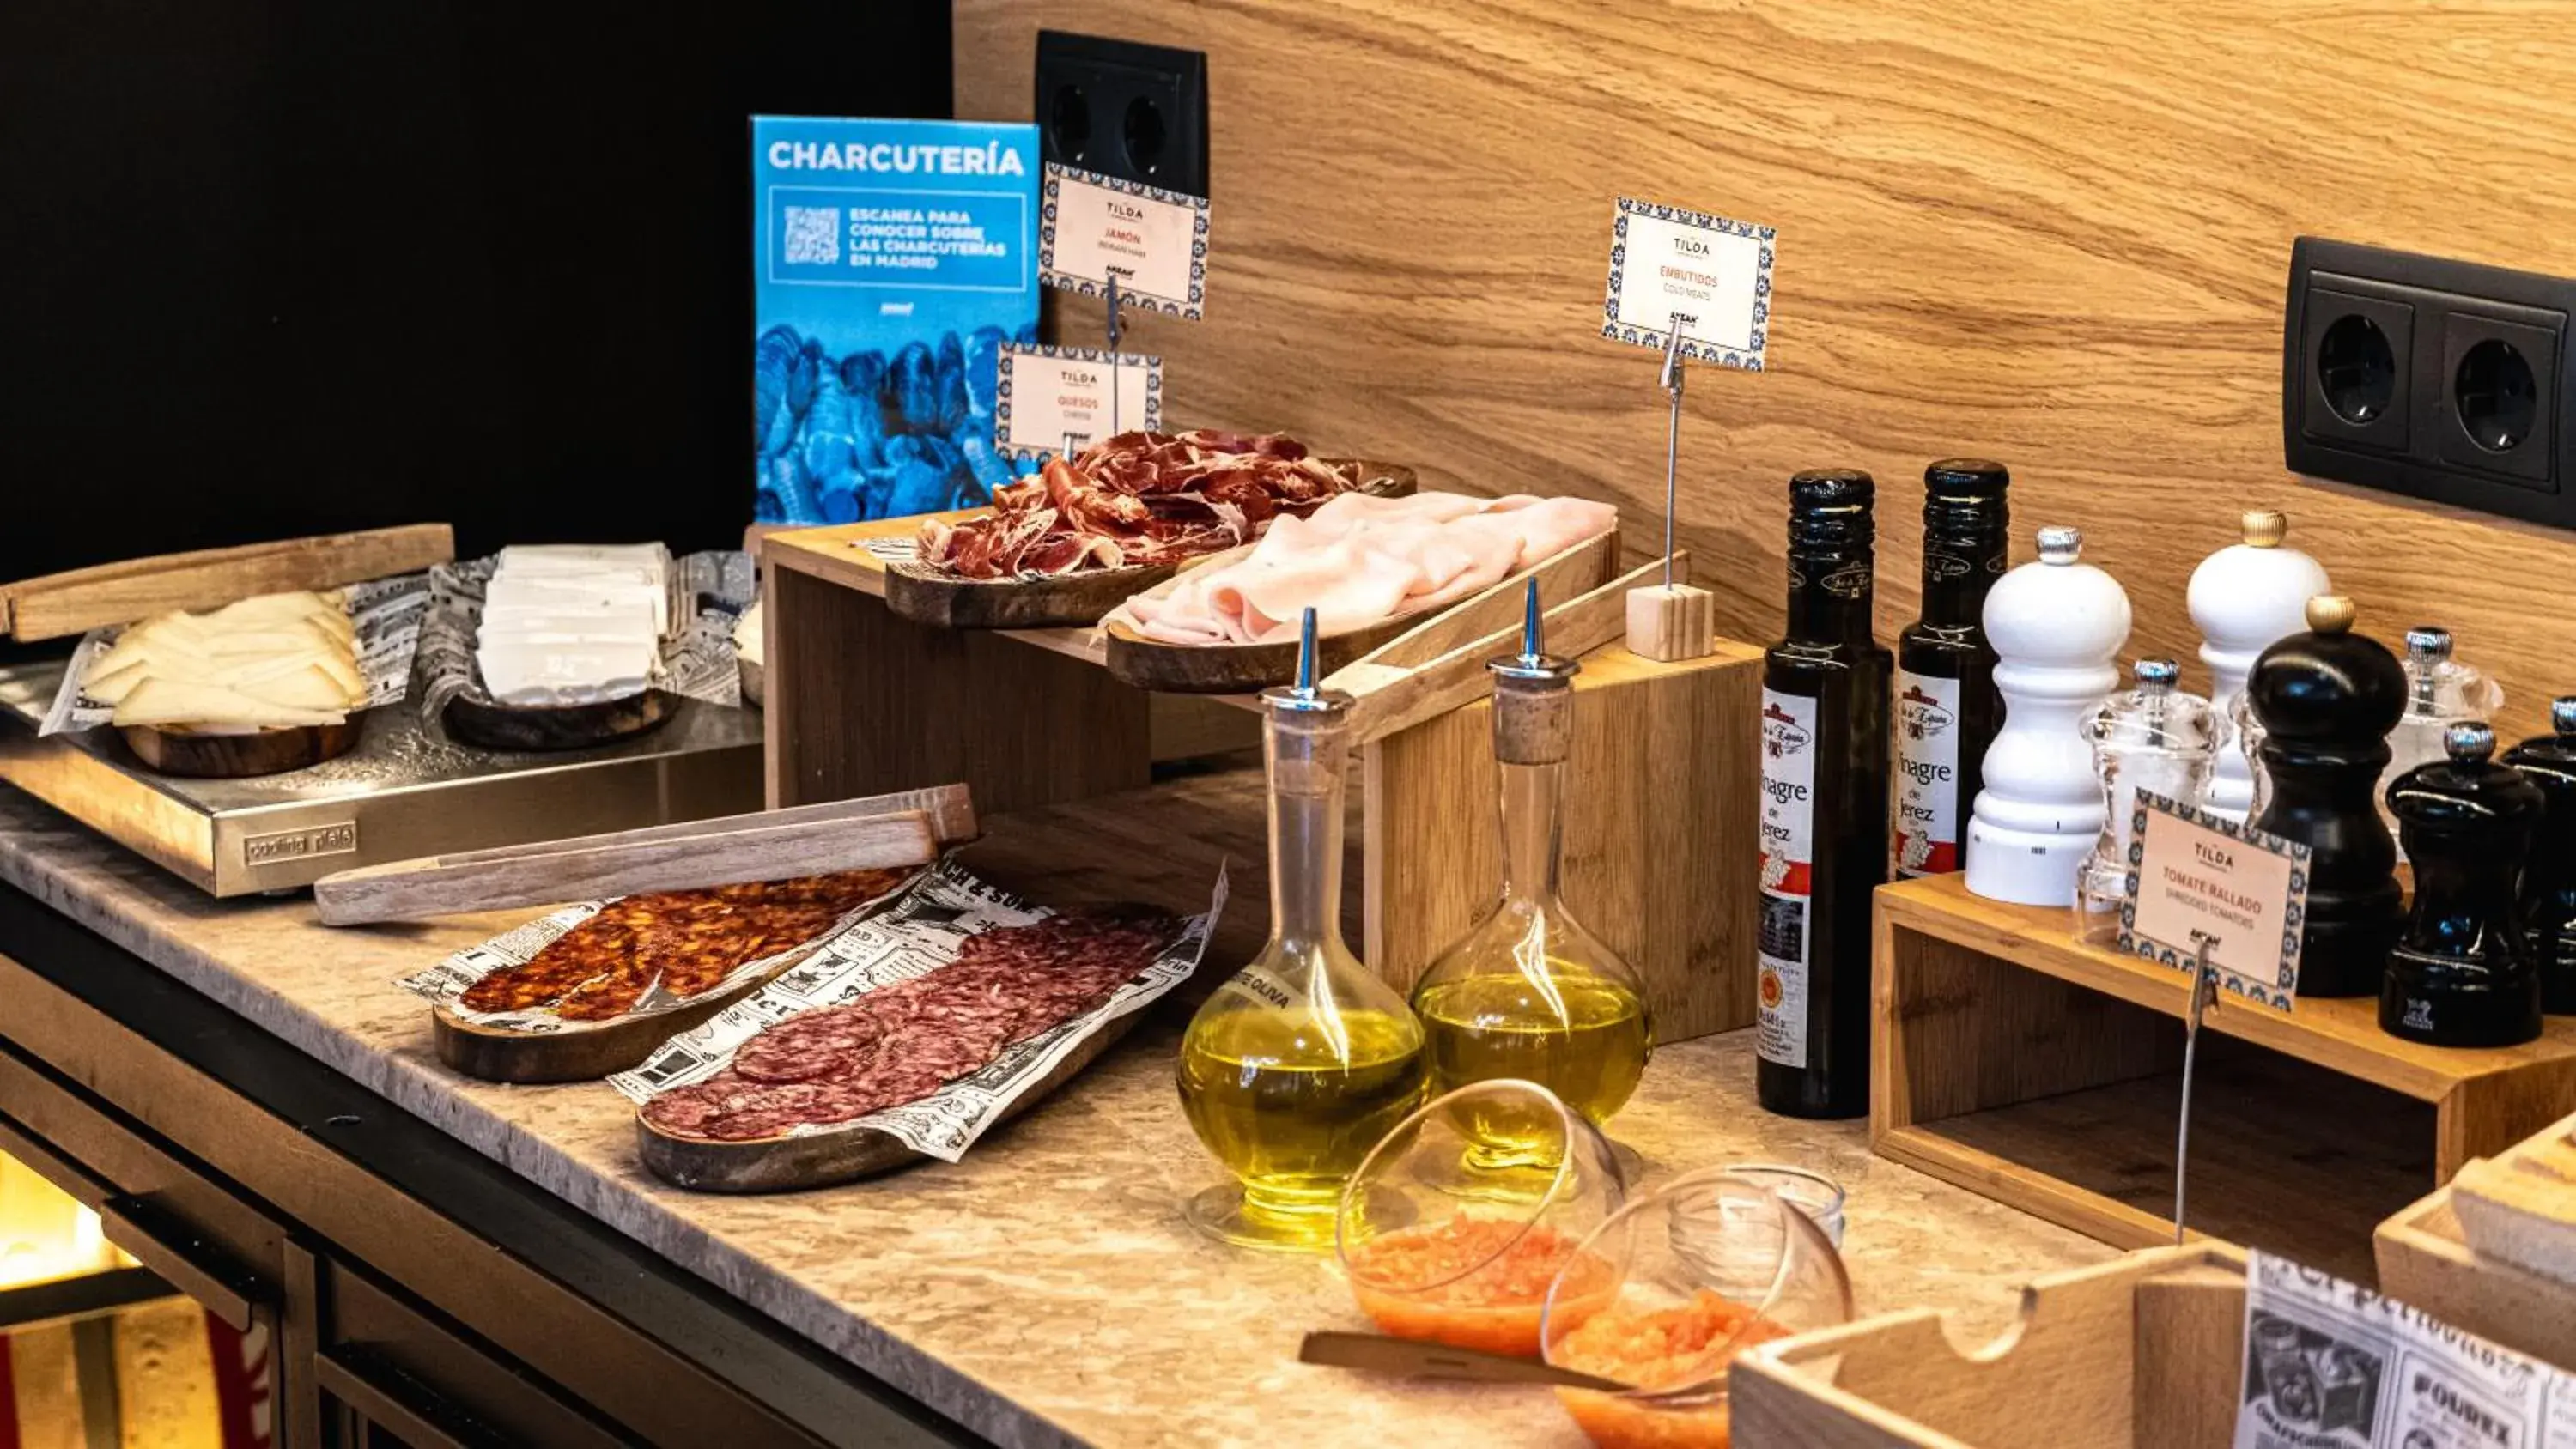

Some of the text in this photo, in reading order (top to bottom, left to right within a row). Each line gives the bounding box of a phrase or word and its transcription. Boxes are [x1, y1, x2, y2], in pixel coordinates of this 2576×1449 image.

[769, 140, 1025, 177] CHARCUTERÍA
[850, 208, 971, 224] ESCANEA PARA
[1107, 202, 1143, 220] TILDA
[850, 223, 984, 240] CONOCER SOBRE
[850, 239, 880, 252] LAS
[1674, 238, 1710, 255] TILDA
[850, 253, 938, 270] EN MADRID
[1660, 264, 1718, 288] EMBUTIDOS
[1061, 371, 1097, 384] TILDA
[1057, 396, 1098, 409] QUESOS
[1898, 751, 1952, 785] inagre
[1761, 769, 1807, 804] inagre
[2195, 842, 2234, 867] TILDA
[2163, 865, 2206, 894] TOMATE
[2209, 882, 2263, 915] RALLADO
[1251, 979, 1289, 1009] OLIVA
